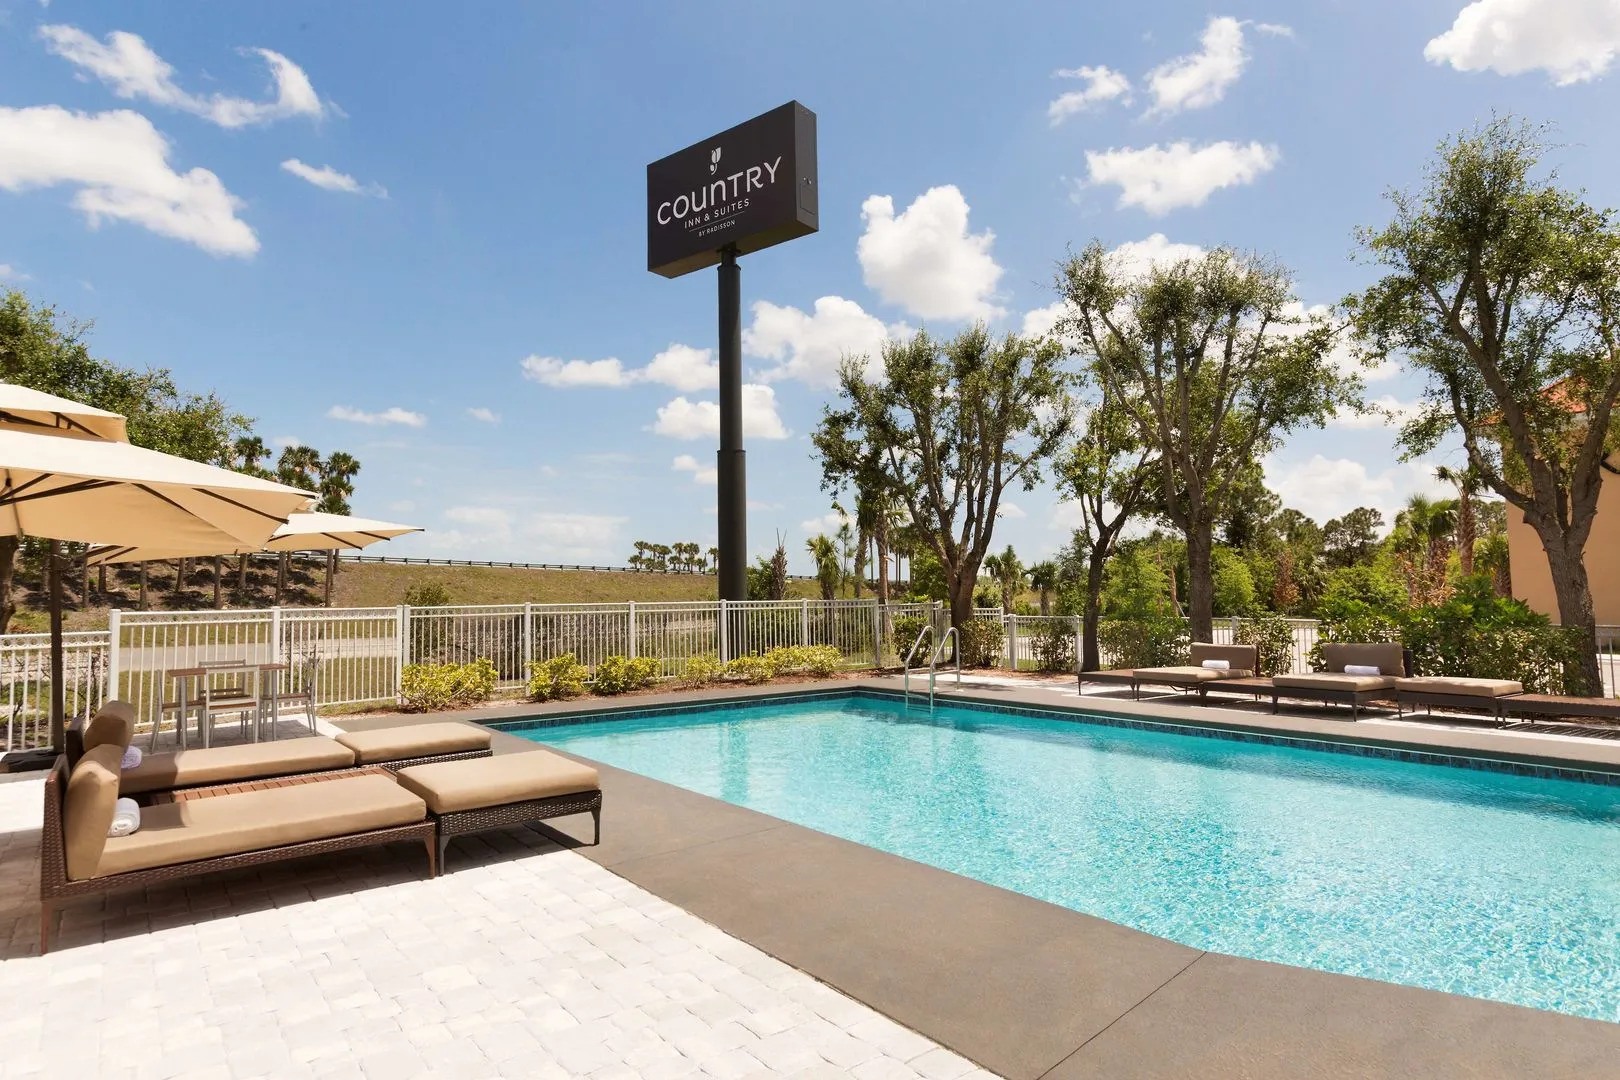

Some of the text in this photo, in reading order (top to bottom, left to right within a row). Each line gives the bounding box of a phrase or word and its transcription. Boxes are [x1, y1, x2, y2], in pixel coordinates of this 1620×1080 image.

[684, 198, 750, 229] INN & SUITES
[698, 220, 736, 237] BY RADISSON
